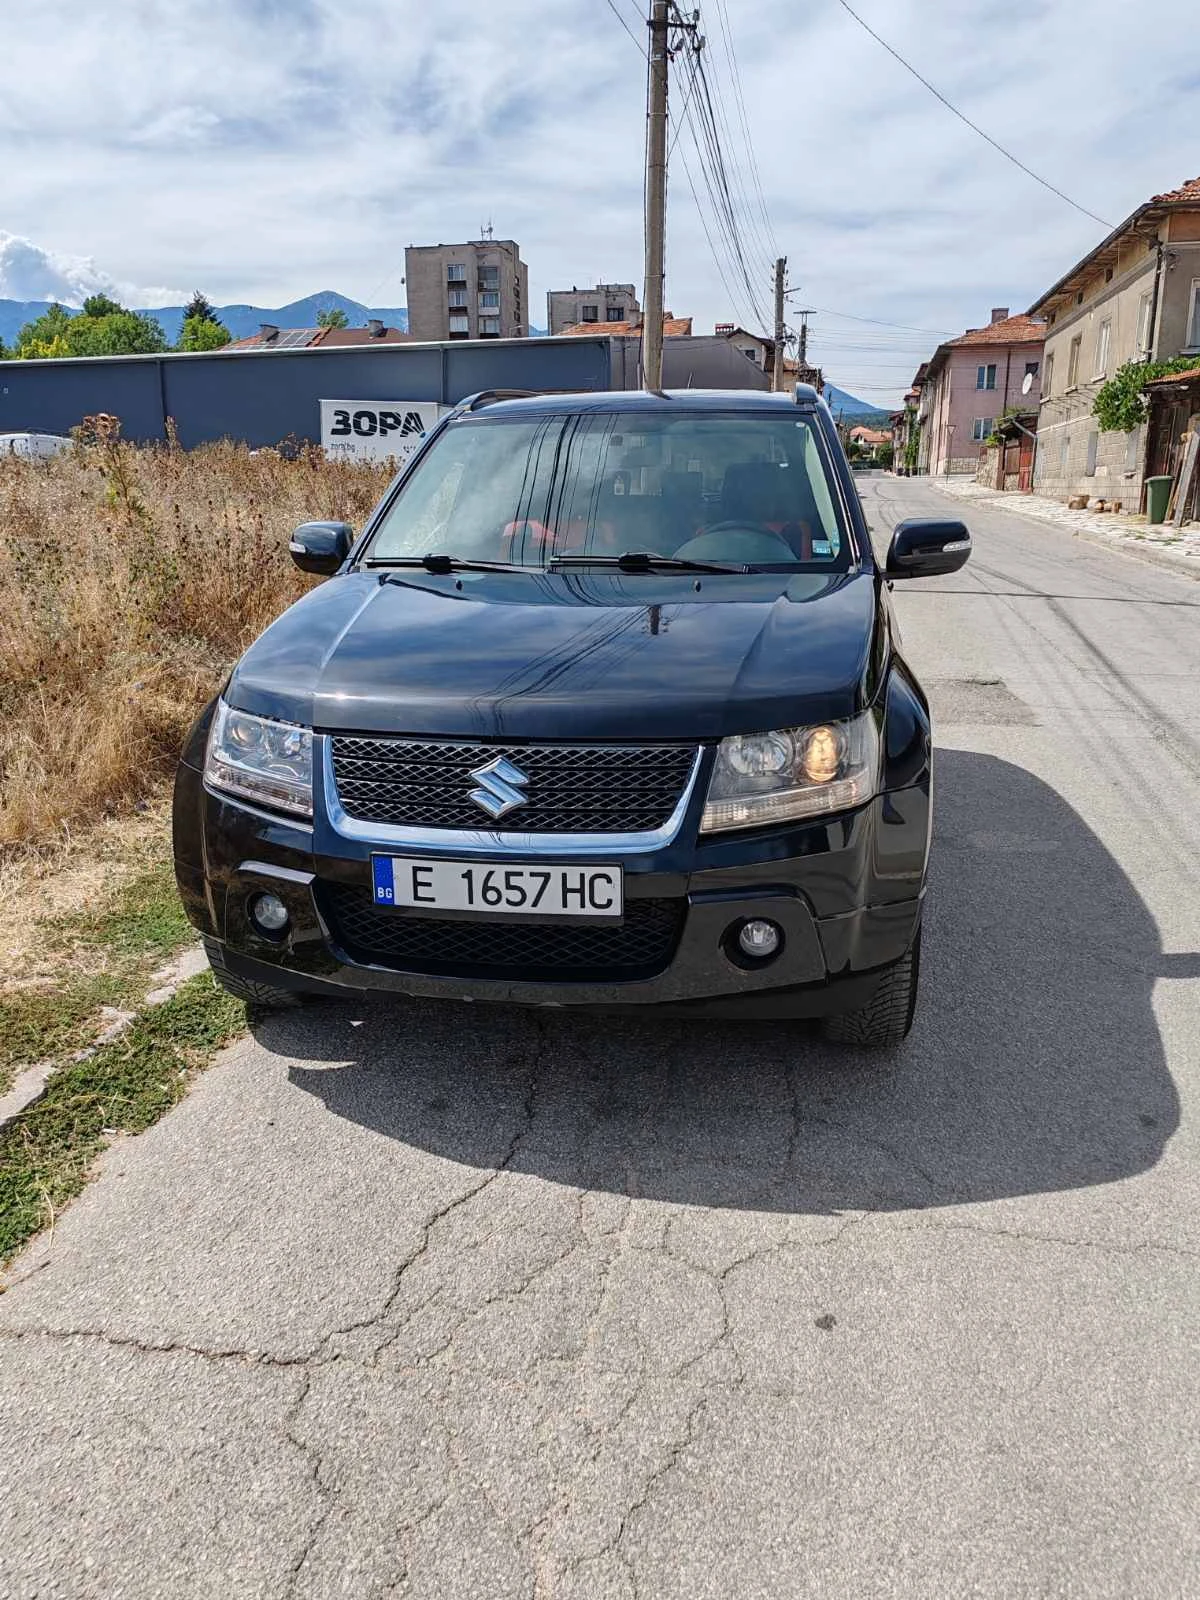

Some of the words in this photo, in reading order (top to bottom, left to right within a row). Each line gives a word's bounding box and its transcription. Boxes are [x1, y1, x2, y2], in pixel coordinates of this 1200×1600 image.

[330, 410, 425, 438] ЗОРА
[377, 887, 393, 898] BG
[412, 865, 436, 903] E
[461, 869, 551, 908] 1657
[561, 872, 613, 910] HC
